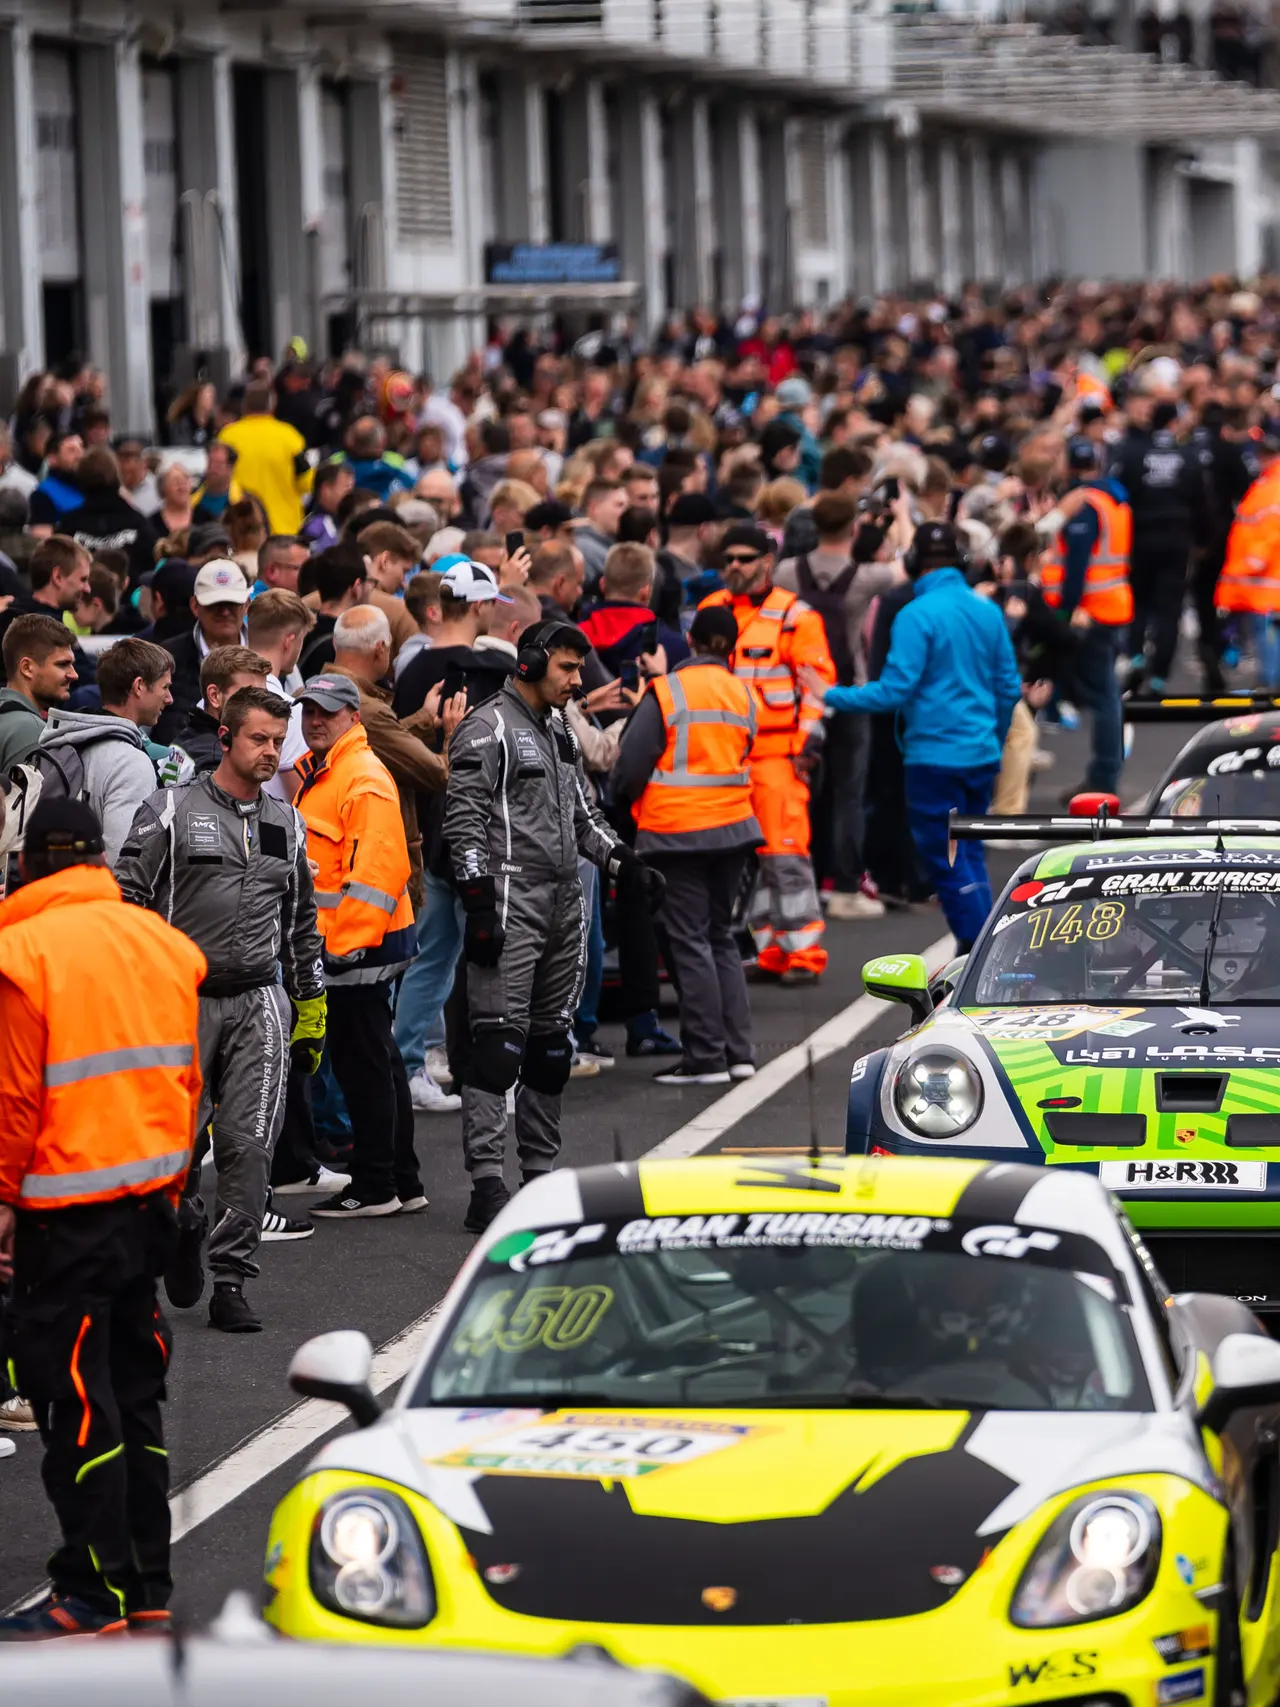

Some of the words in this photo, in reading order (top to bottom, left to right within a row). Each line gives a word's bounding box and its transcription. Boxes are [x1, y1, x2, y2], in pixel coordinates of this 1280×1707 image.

[1088, 853, 1191, 866] BLACK
[1101, 872, 1184, 891] GRAN
[1101, 887, 1129, 897] THE
[1027, 901, 1126, 949] 148
[978, 1013, 1076, 1028] 148
[254, 1062, 273, 1138] Walkenhorst
[1127, 1161, 1207, 1183] H&R
[617, 1215, 740, 1245] GRAN
[453, 1284, 615, 1357] 450
[519, 1429, 694, 1456] 450
